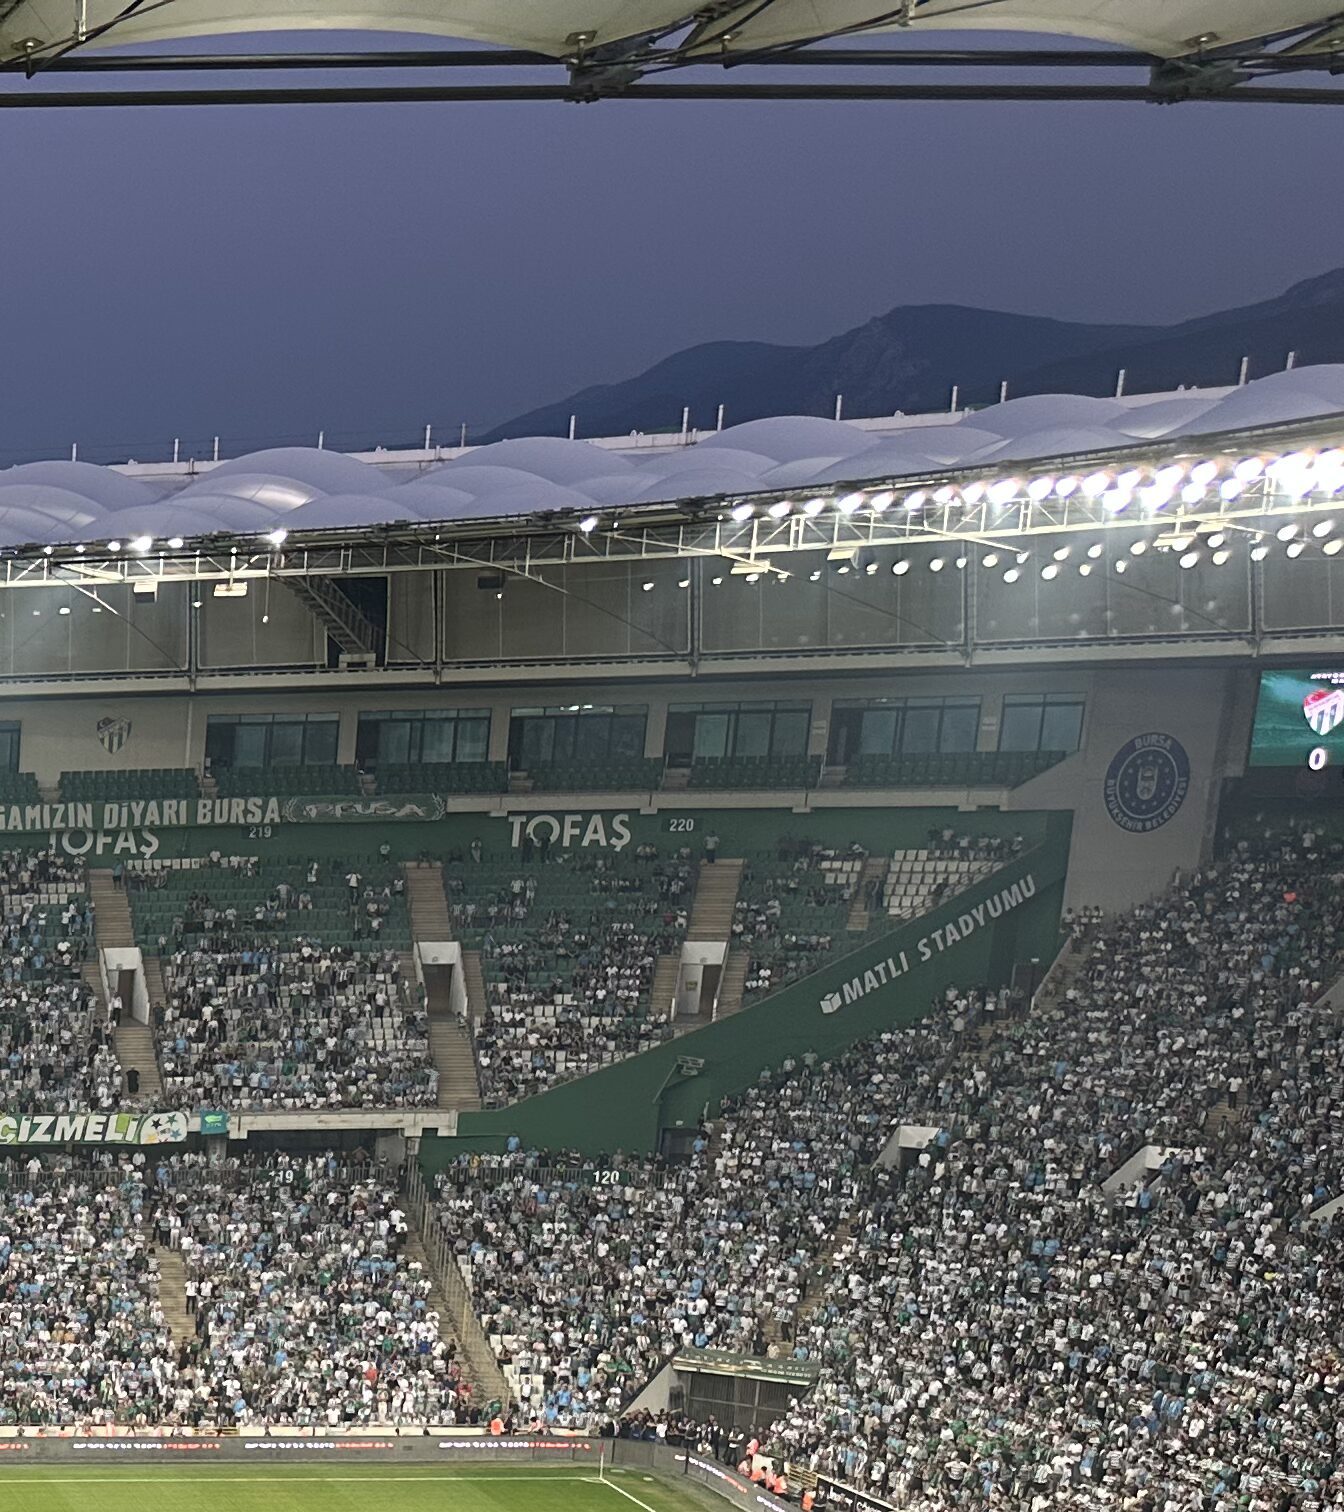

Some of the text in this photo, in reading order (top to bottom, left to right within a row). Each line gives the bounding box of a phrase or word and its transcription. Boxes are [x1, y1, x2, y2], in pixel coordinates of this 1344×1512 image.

[1134, 733, 1172, 750] BURSA
[1308, 747, 1327, 771] 0
[197, 796, 281, 826] BURSA
[248, 825, 272, 839] 219
[508, 814, 631, 852] TOFAŞ
[669, 818, 694, 832] 220
[842, 874, 1036, 1005] MATLI STADYUMU
[592, 1171, 619, 1185] 120
